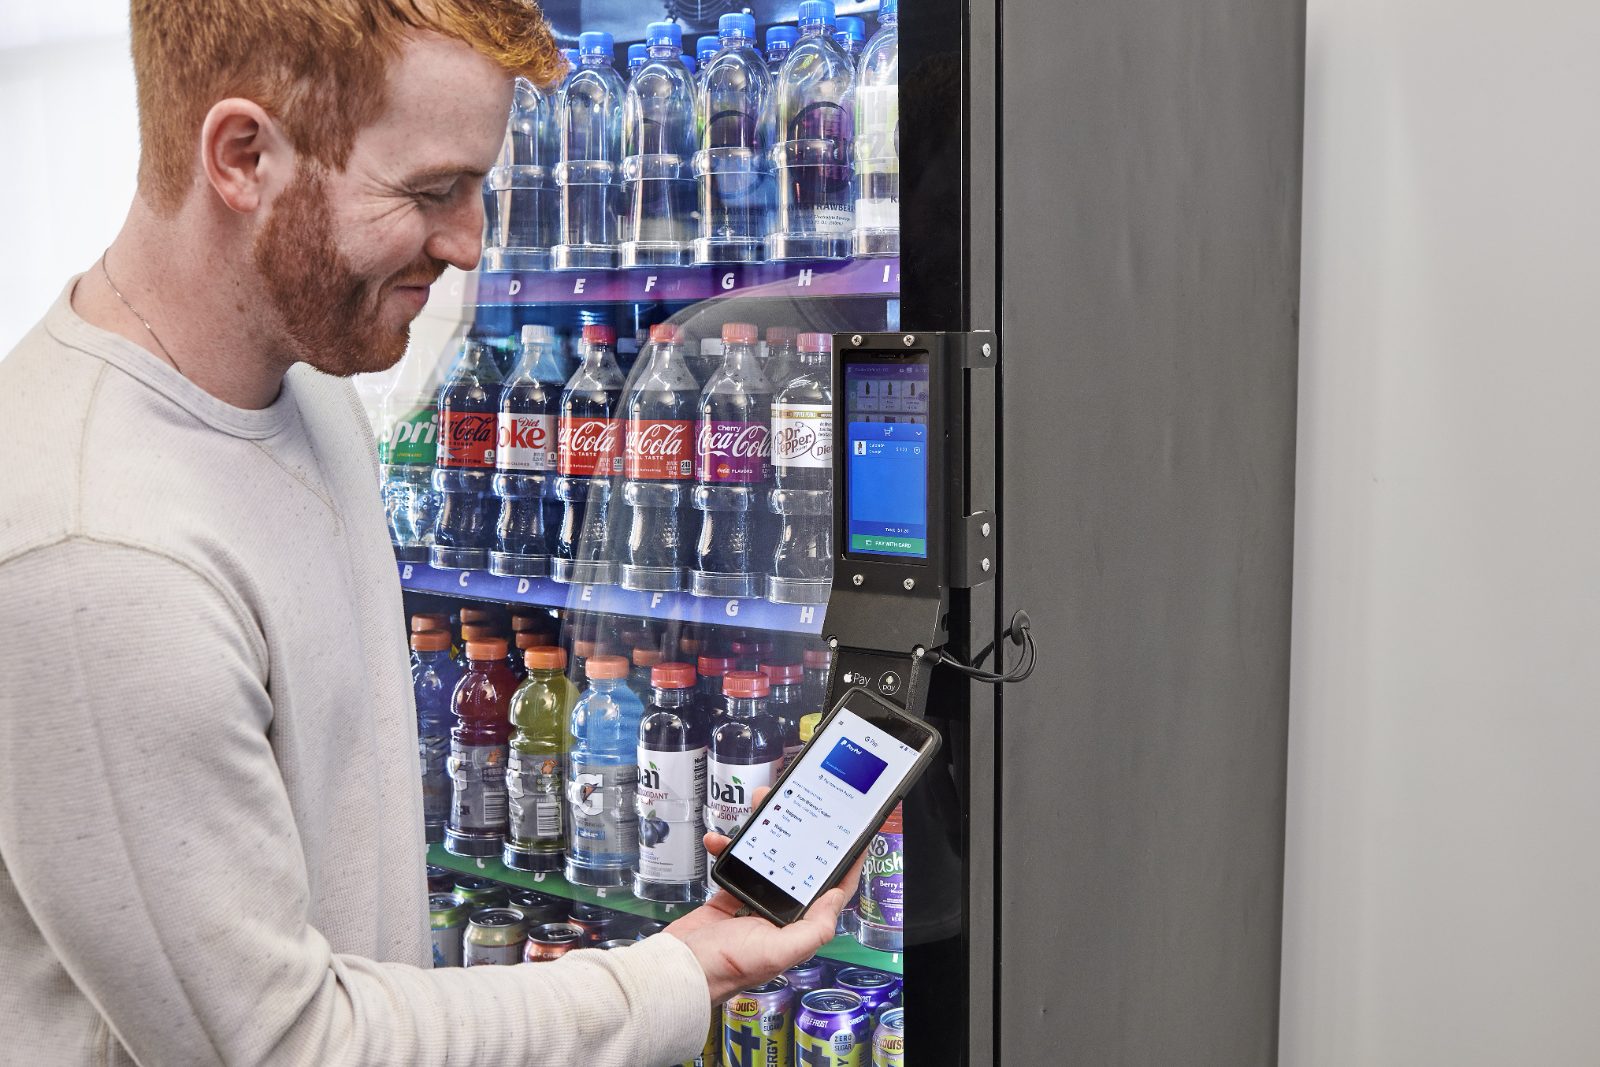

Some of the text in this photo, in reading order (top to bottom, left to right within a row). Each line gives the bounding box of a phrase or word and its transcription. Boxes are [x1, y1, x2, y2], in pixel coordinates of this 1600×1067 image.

[722, 273, 734, 289] G
[798, 269, 812, 286] H
[883, 265, 890, 282] I
[508, 280, 521, 295] D
[574, 279, 586, 294] E
[645, 276, 657, 292] F
[518, 417, 540, 427] Diet
[498, 420, 544, 449] oke
[785, 427, 800, 441] Dr
[402, 565, 413, 579] B
[459, 571, 470, 587] C
[517, 578, 530, 594] D
[582, 585, 593, 601] E
[651, 592, 664, 608] F
[725, 600, 739, 616] G
[800, 606, 814, 624] H
[853, 672, 871, 688] Pay
[846, 743, 863, 756] PayPal
[569, 773, 604, 816] G
[710, 775, 744, 804] bai
[880, 880, 898, 889] Berry
[731, 1001, 758, 1012] burst
[813, 1019, 828, 1028] FROST
